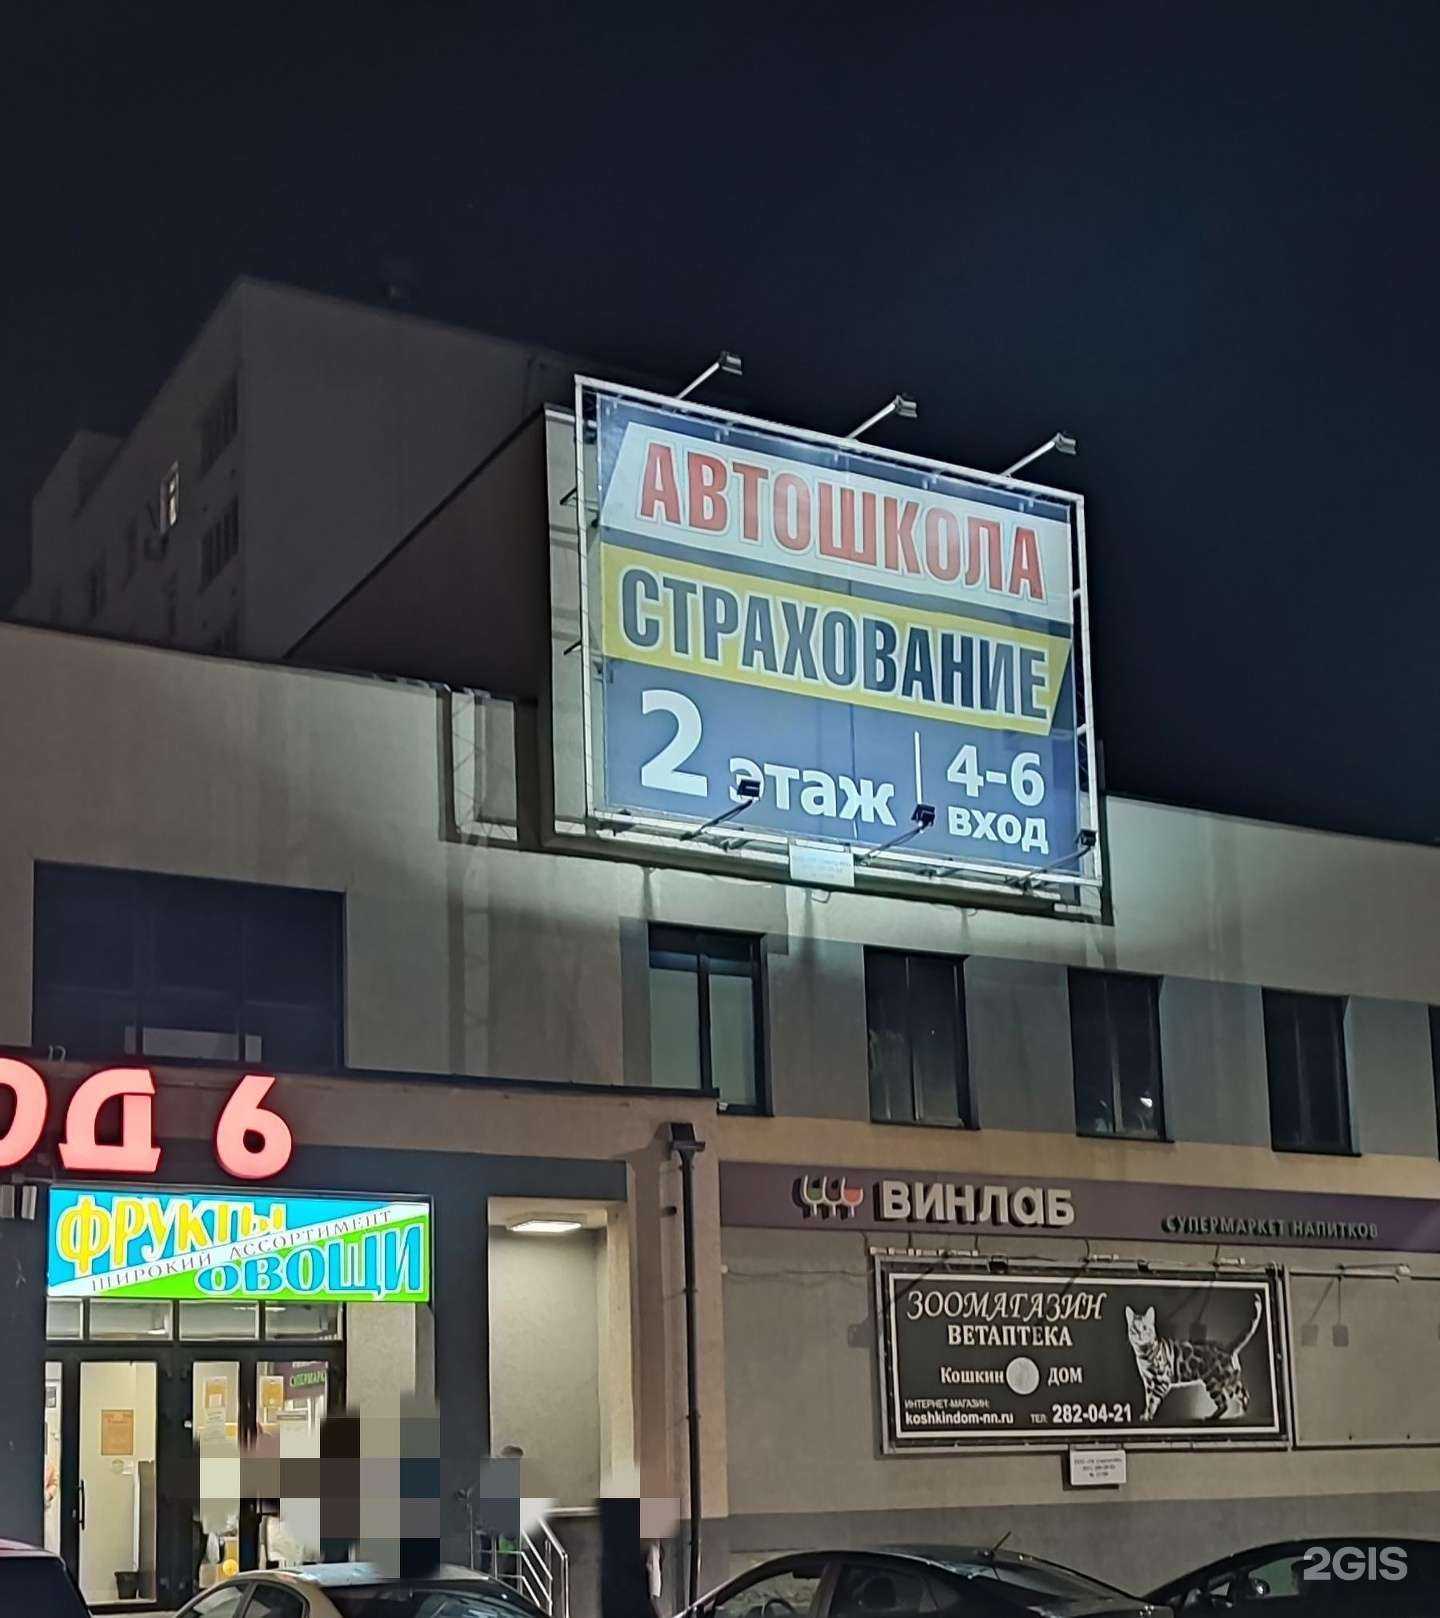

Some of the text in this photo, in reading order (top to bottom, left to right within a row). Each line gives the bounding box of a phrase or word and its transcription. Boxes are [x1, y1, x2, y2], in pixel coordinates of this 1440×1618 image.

[640, 441, 1047, 602] АВТОШКОЛА
[620, 567, 1048, 720] СТРАХОВАНИЕ
[640, 689, 897, 826] 2 этаж
[947, 744, 1046, 806] 4-6
[215, 1074, 293, 1180] 6
[58, 1194, 286, 1275] ФРУКТЫ
[90, 1209, 393, 1293] ШИРОКИЙ АССОРТИМЕНТ
[195, 1223, 423, 1296] ОВОЩИ
[1164, 1214, 1379, 1241] СУПЕРМАРКЕТ НАПИТКОВ
[906, 1290, 1108, 1322] ЗООМАГАЗИН
[948, 1324, 1073, 1347] ВЕТАПТЕКА
[940, 1364, 1005, 1386] Кошкин
[905, 1410, 1014, 1426] koshkindom-nn.ru
[1052, 1403, 1132, 1424] 282-04-21
